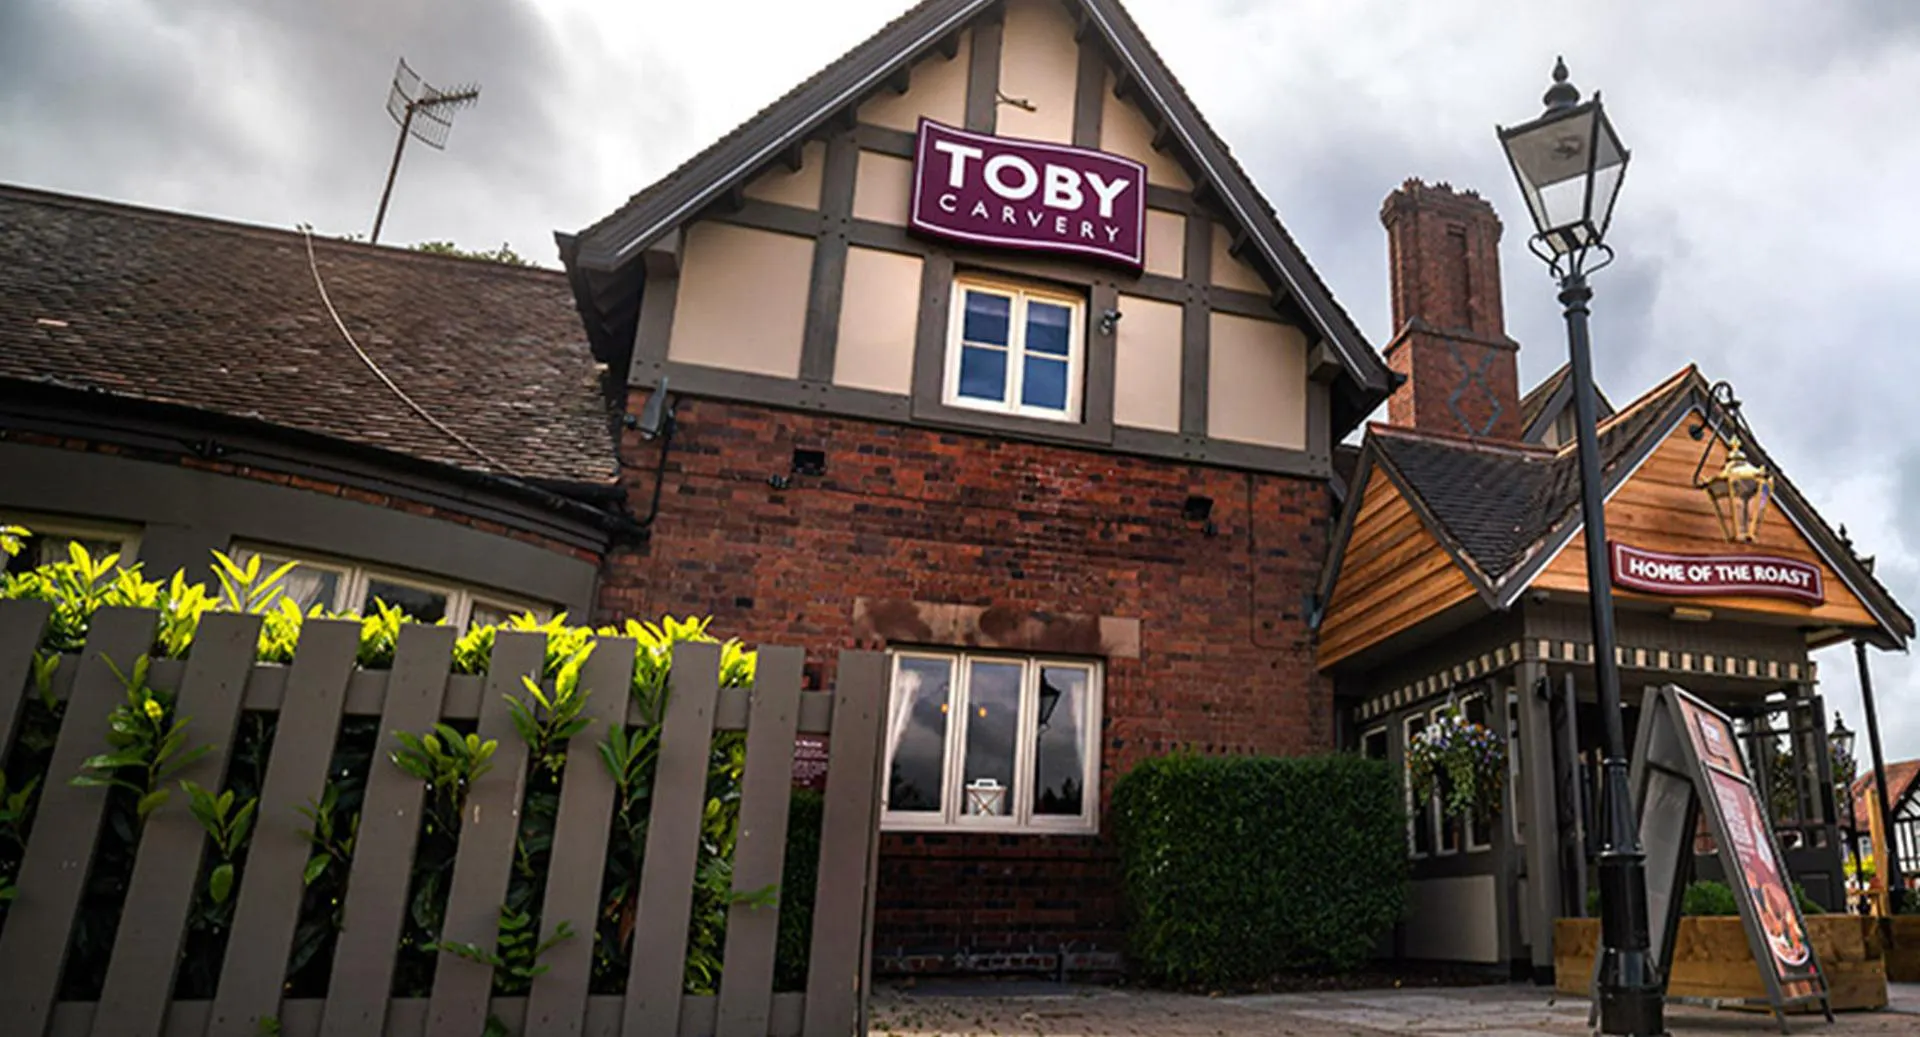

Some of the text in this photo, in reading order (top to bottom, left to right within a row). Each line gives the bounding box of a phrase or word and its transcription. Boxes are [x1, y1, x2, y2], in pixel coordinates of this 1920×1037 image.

[934, 139, 1131, 219] TOBY
[938, 193, 1120, 243] CARVERY
[1628, 557, 1812, 587] HOME OF THE ROAST
